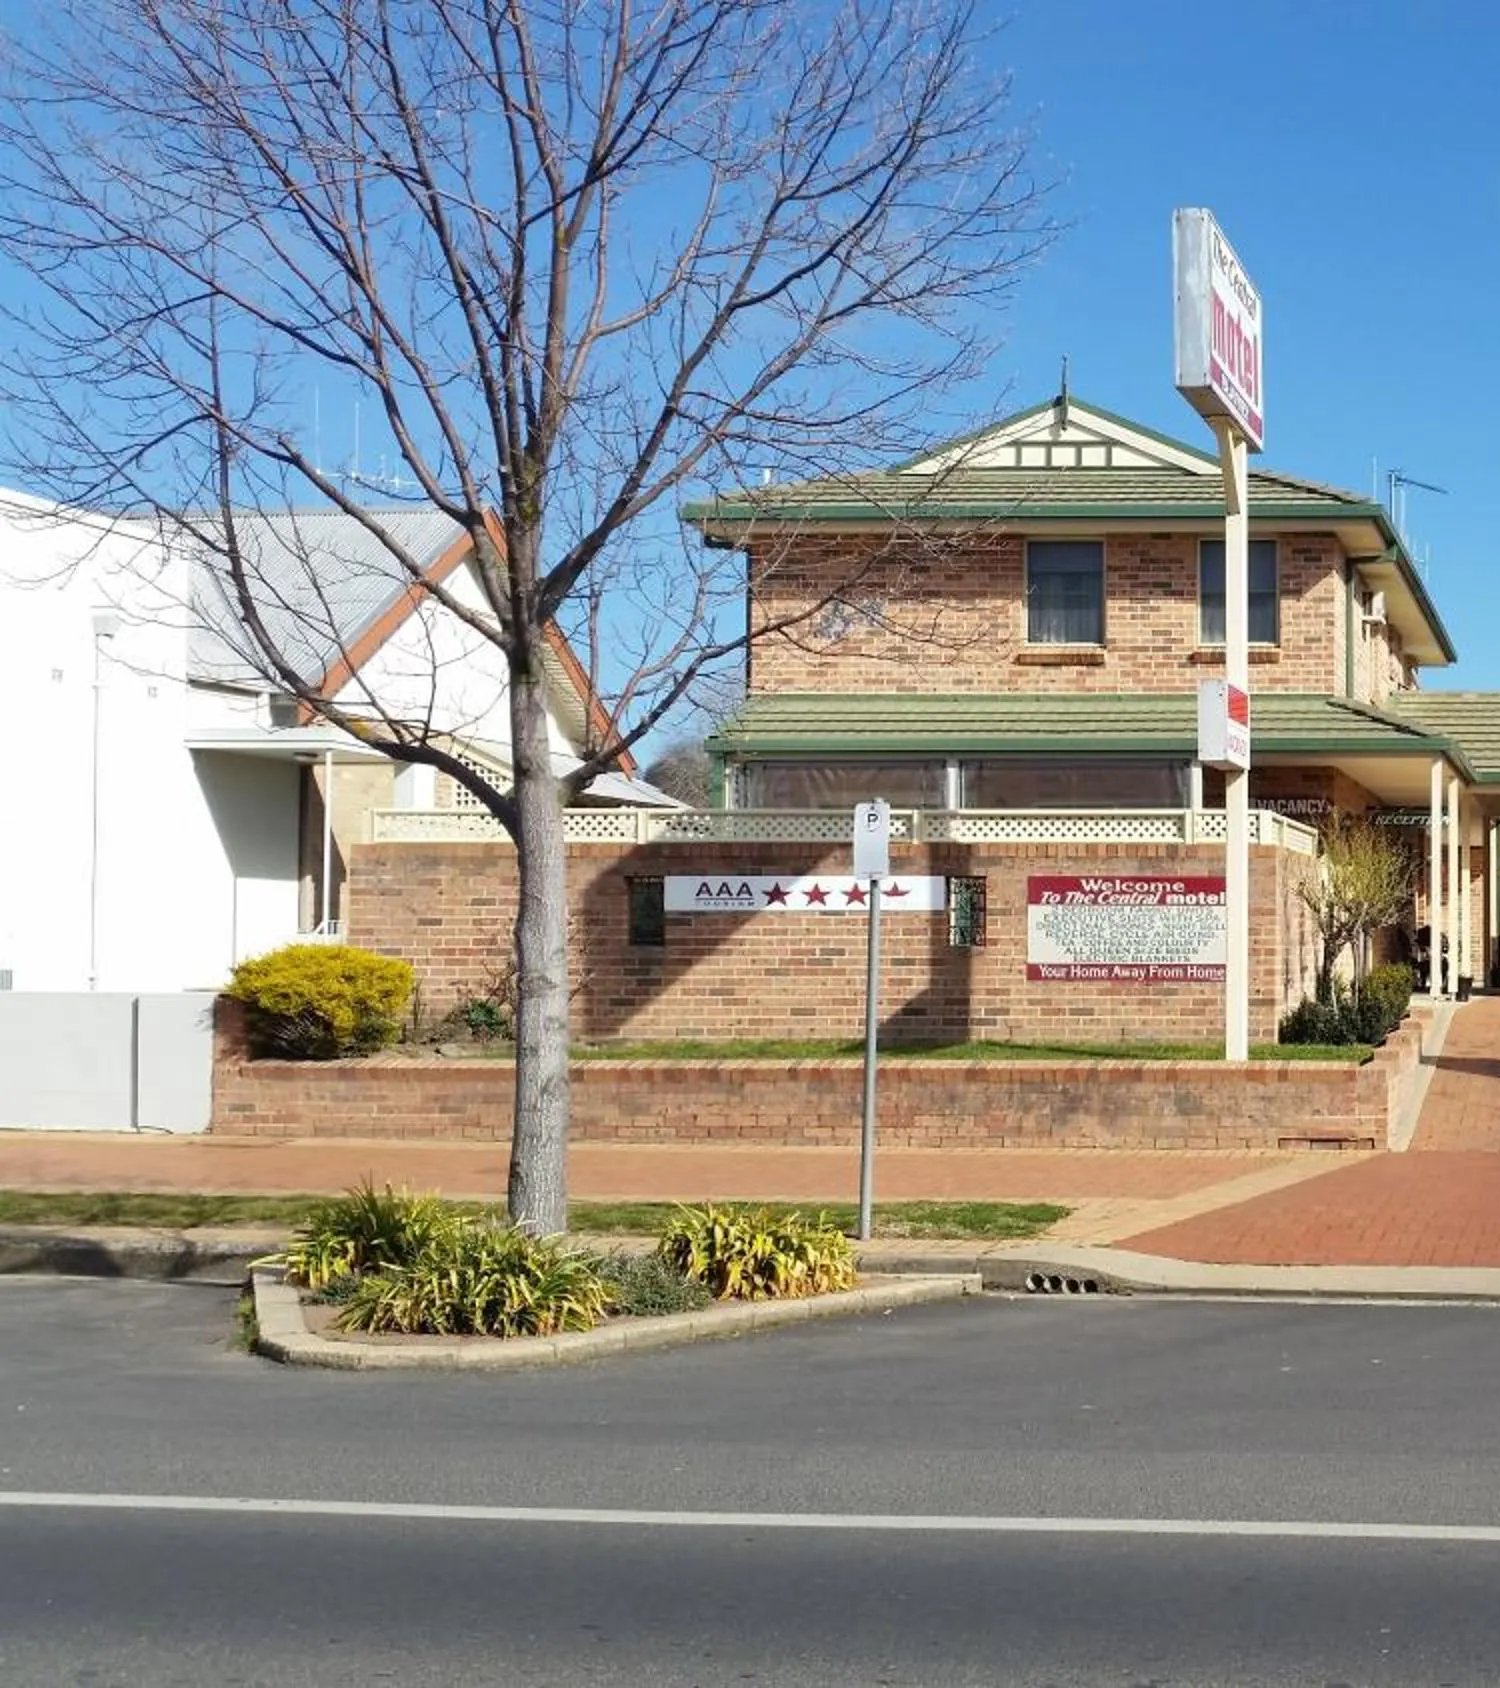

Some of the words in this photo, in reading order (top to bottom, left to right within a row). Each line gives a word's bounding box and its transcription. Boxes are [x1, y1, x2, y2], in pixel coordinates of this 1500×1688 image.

[1212, 290, 1259, 410] motel
[1257, 799, 1326, 814] VACANCY
[695, 882, 753, 897] AAA
[1081, 879, 1185, 893] Welcome
[1040, 891, 1061, 904] To
[1065, 891, 1095, 904] The
[1098, 890, 1161, 905] Central
[1166, 891, 1225, 905] motel
[1039, 965, 1067, 978] Your
[1070, 965, 1108, 977] Home
[1112, 965, 1146, 980] Away
[1149, 965, 1183, 977] From
[1187, 965, 1225, 977] Home
